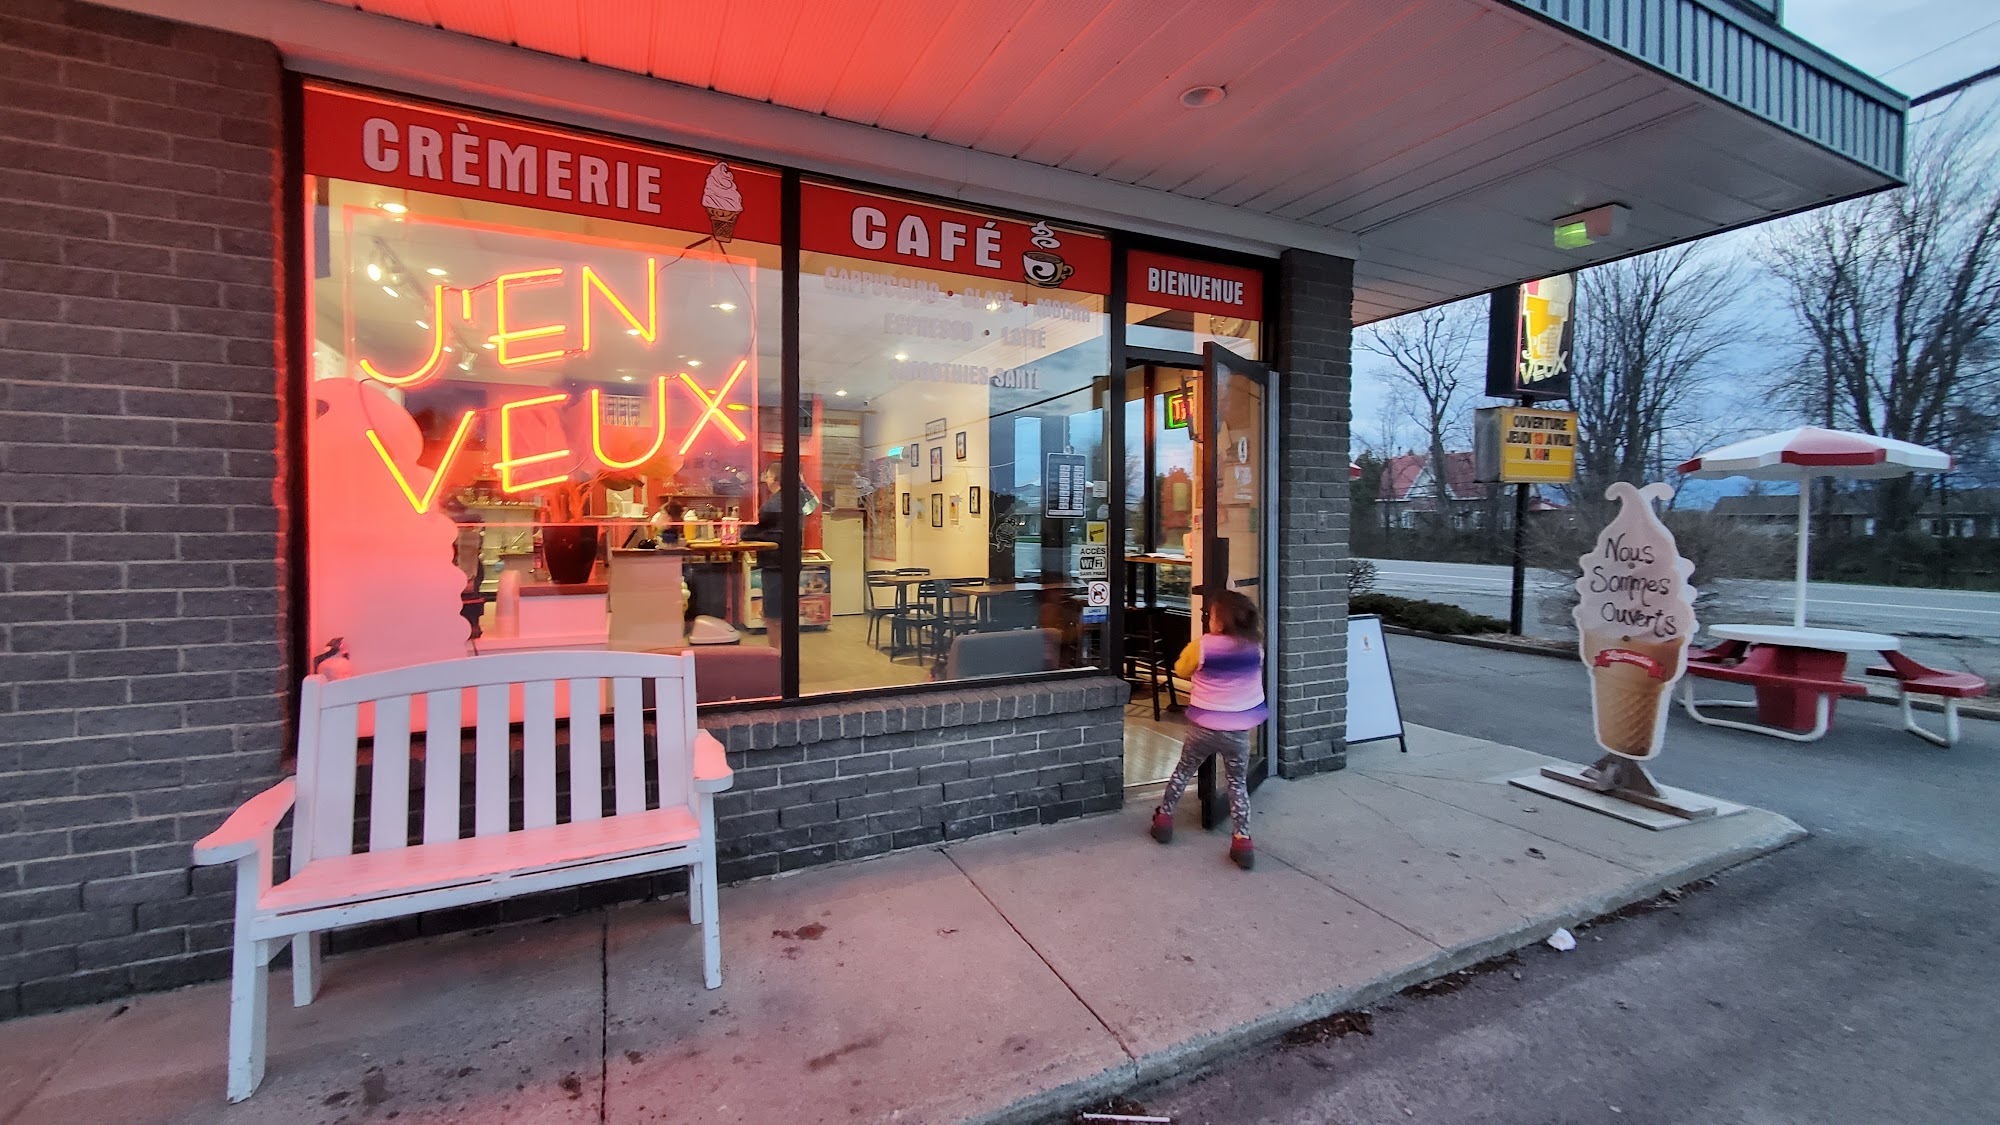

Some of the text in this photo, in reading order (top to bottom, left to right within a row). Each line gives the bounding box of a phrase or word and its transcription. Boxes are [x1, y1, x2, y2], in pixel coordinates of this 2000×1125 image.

[362, 117, 662, 215] CRÈMERIE
[852, 206, 1002, 269] CAFÉ
[824, 265, 939, 304] CAPPUCCINO
[1034, 297, 1091, 323] MOCHA
[1147, 266, 1244, 305] BIENVENUE
[359, 257, 656, 384] J'EN
[883, 311, 974, 342] ESPRESSO
[365, 359, 749, 514] VEUX
[1507, 431, 1531, 444] JEUDI
[1546, 433, 1573, 447] AVRIL
[1514, 415, 1568, 430] OUVERTURE
[1080, 547, 1106, 555] ACCÈS
[1605, 532, 1655, 564] Nous
[1590, 565, 1671, 607] Sommes
[1601, 602, 1677, 638] Ouverts
